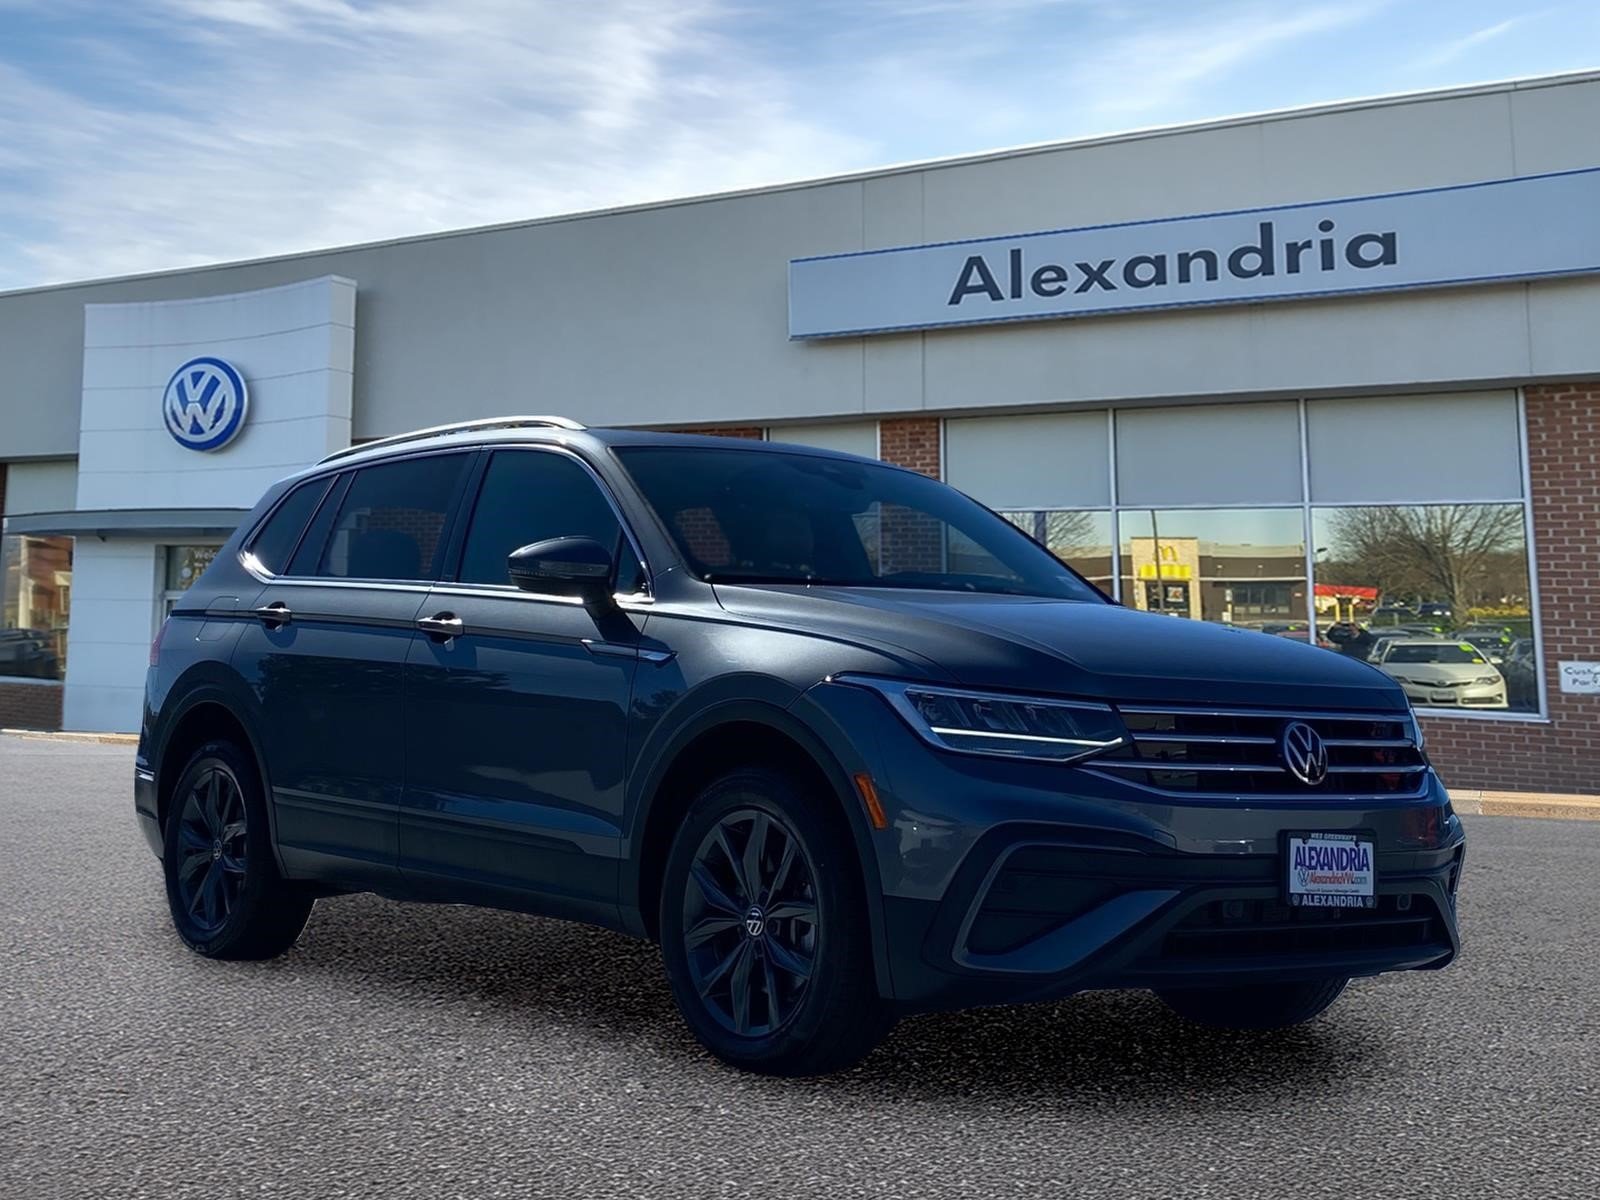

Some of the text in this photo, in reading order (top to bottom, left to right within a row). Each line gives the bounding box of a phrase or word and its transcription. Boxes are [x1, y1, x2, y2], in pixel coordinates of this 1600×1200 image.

[947, 219, 1397, 305] Alexandria
[164, 361, 238, 445] VW
[1294, 846, 1370, 872] ALEXANDRIA
[1302, 894, 1363, 907] ALEXANDRIA
